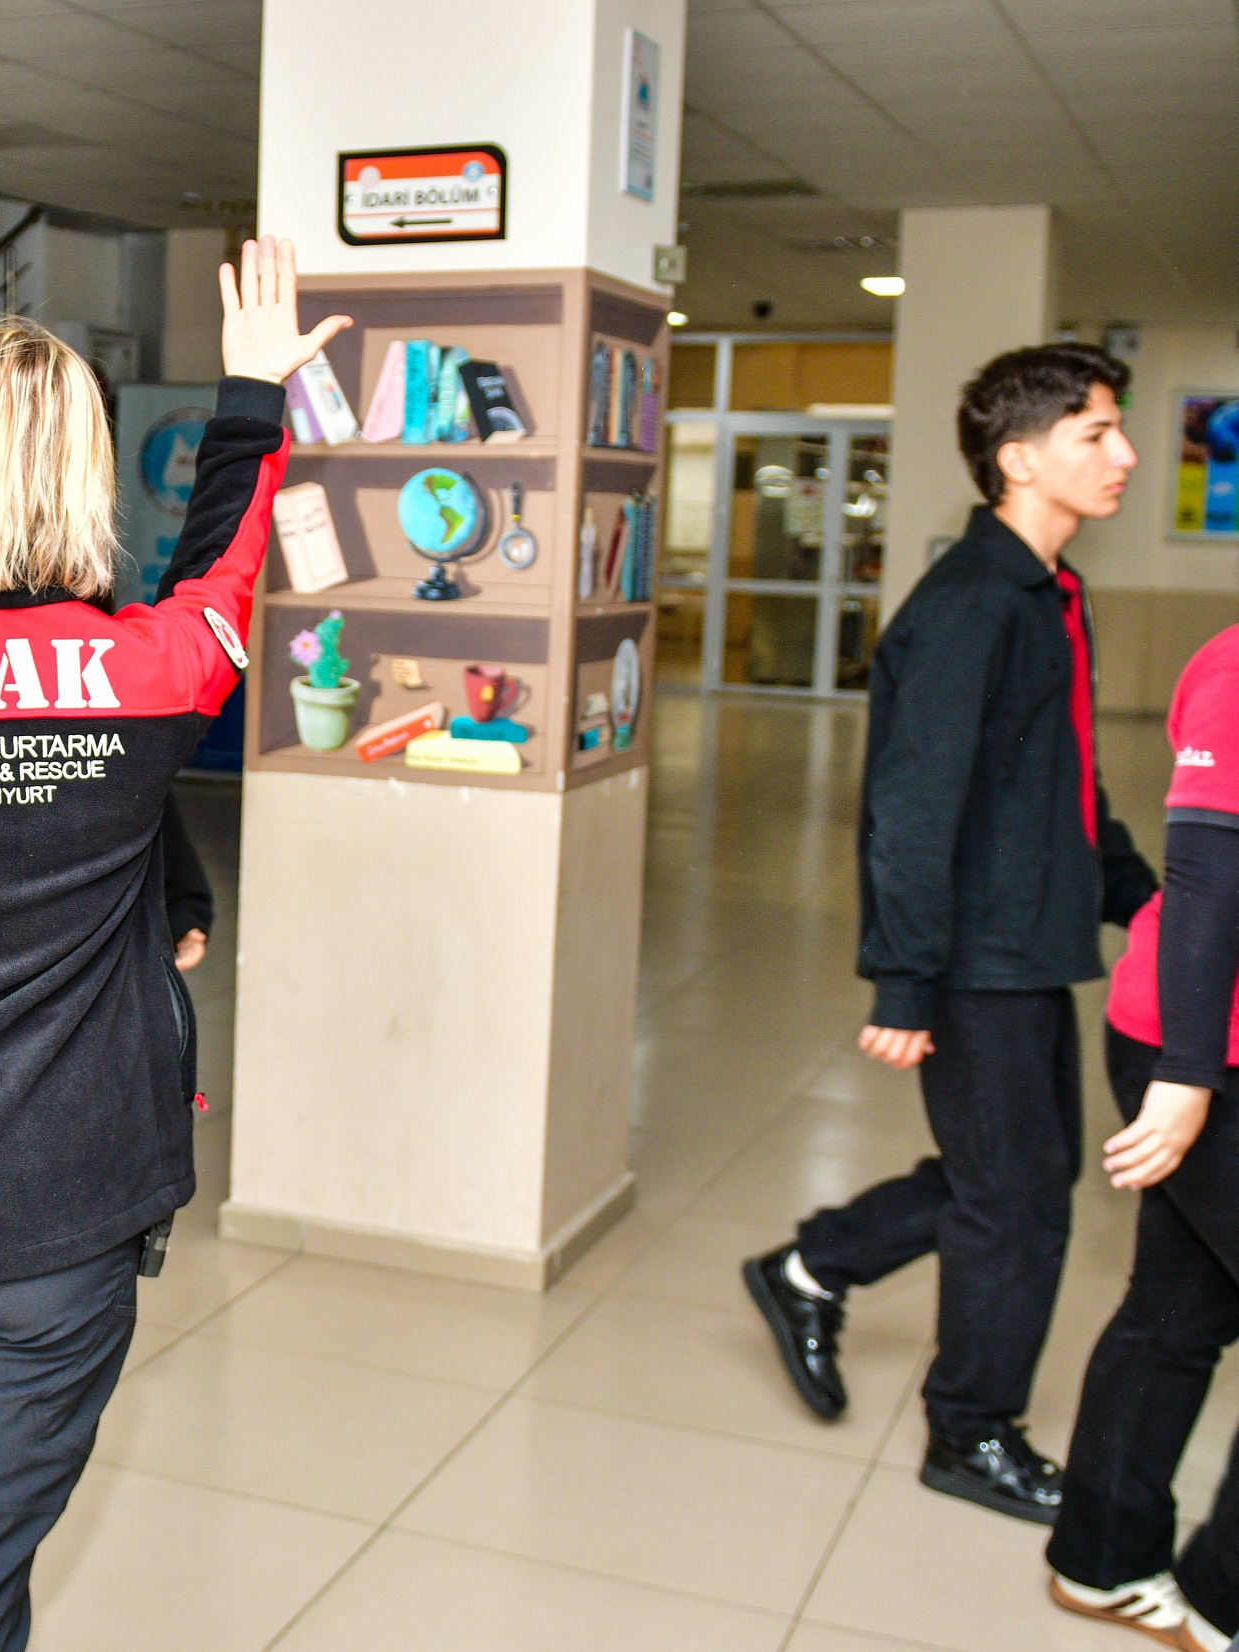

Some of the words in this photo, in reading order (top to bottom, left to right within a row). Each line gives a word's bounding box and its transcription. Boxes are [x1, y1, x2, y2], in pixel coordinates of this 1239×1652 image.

[362, 187, 410, 207] İDARİ
[414, 184, 479, 205] BÖLÜM
[0, 763, 15, 781] &
[19, 760, 106, 780] RESCUE
